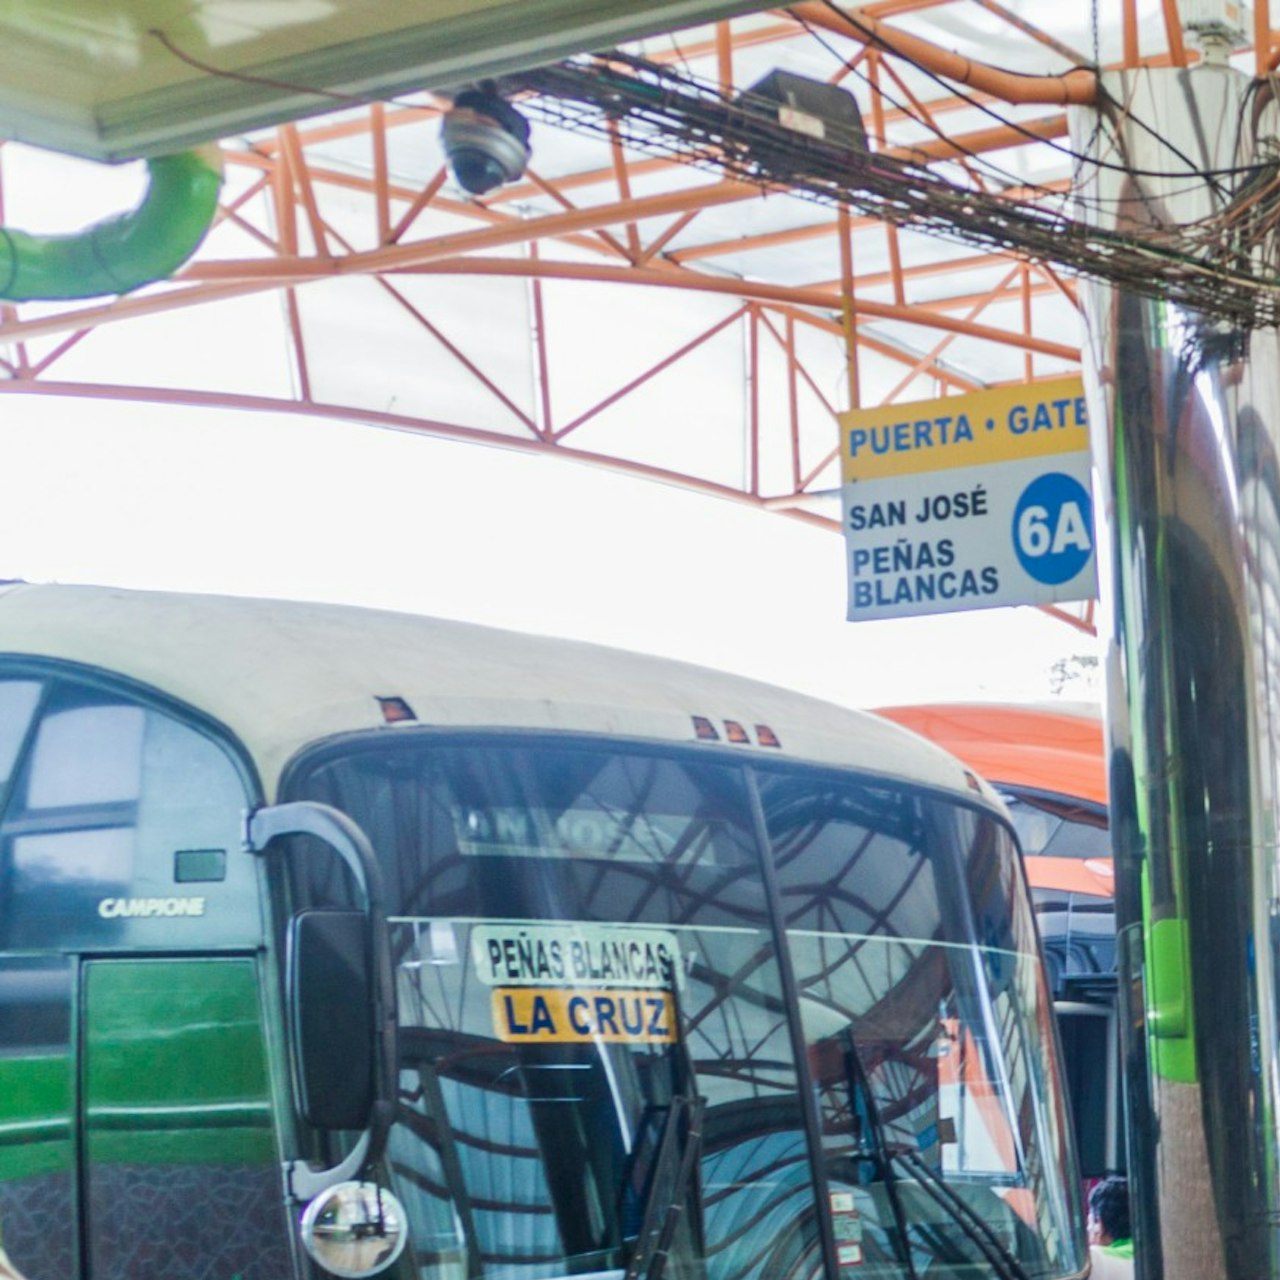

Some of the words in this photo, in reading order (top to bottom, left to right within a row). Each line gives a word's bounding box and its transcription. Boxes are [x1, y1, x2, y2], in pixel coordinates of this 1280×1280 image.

[850, 414, 974, 457] PUERTA
[1008, 397, 1087, 435] GATE
[850, 500, 906, 531] SAN
[916, 484, 987, 523] JOSÉ
[1018, 501, 1092, 558] 6A
[854, 538, 955, 576] PEÑAS
[854, 566, 999, 608] BLANCAS
[98, 897, 206, 918] CAMPIONE
[488, 931, 564, 979] PEÑAS
[569, 940, 675, 981] BLANCAS
[504, 995, 557, 1035] LA
[567, 997, 669, 1036] CRUZ
